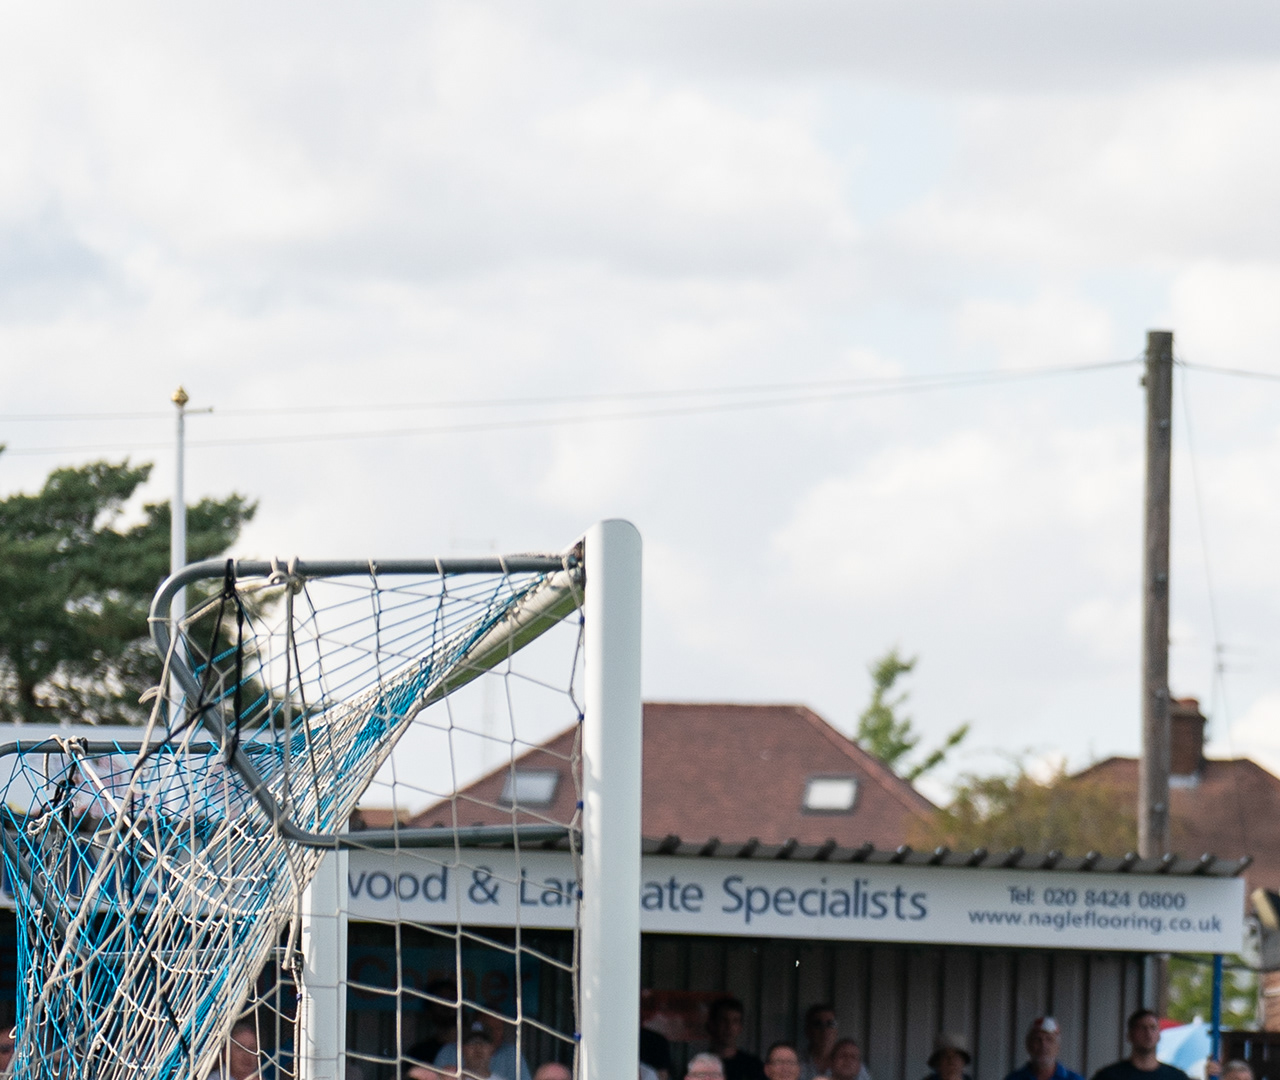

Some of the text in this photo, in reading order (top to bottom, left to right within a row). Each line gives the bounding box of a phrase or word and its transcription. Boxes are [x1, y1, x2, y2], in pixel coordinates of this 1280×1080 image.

[468, 865, 499, 905] &
[721, 875, 927, 924] Specialists
[1007, 886, 1186, 911] Tel: 020 8424 0800
[968, 908, 1222, 934] www.nagleflooring.co.uk
